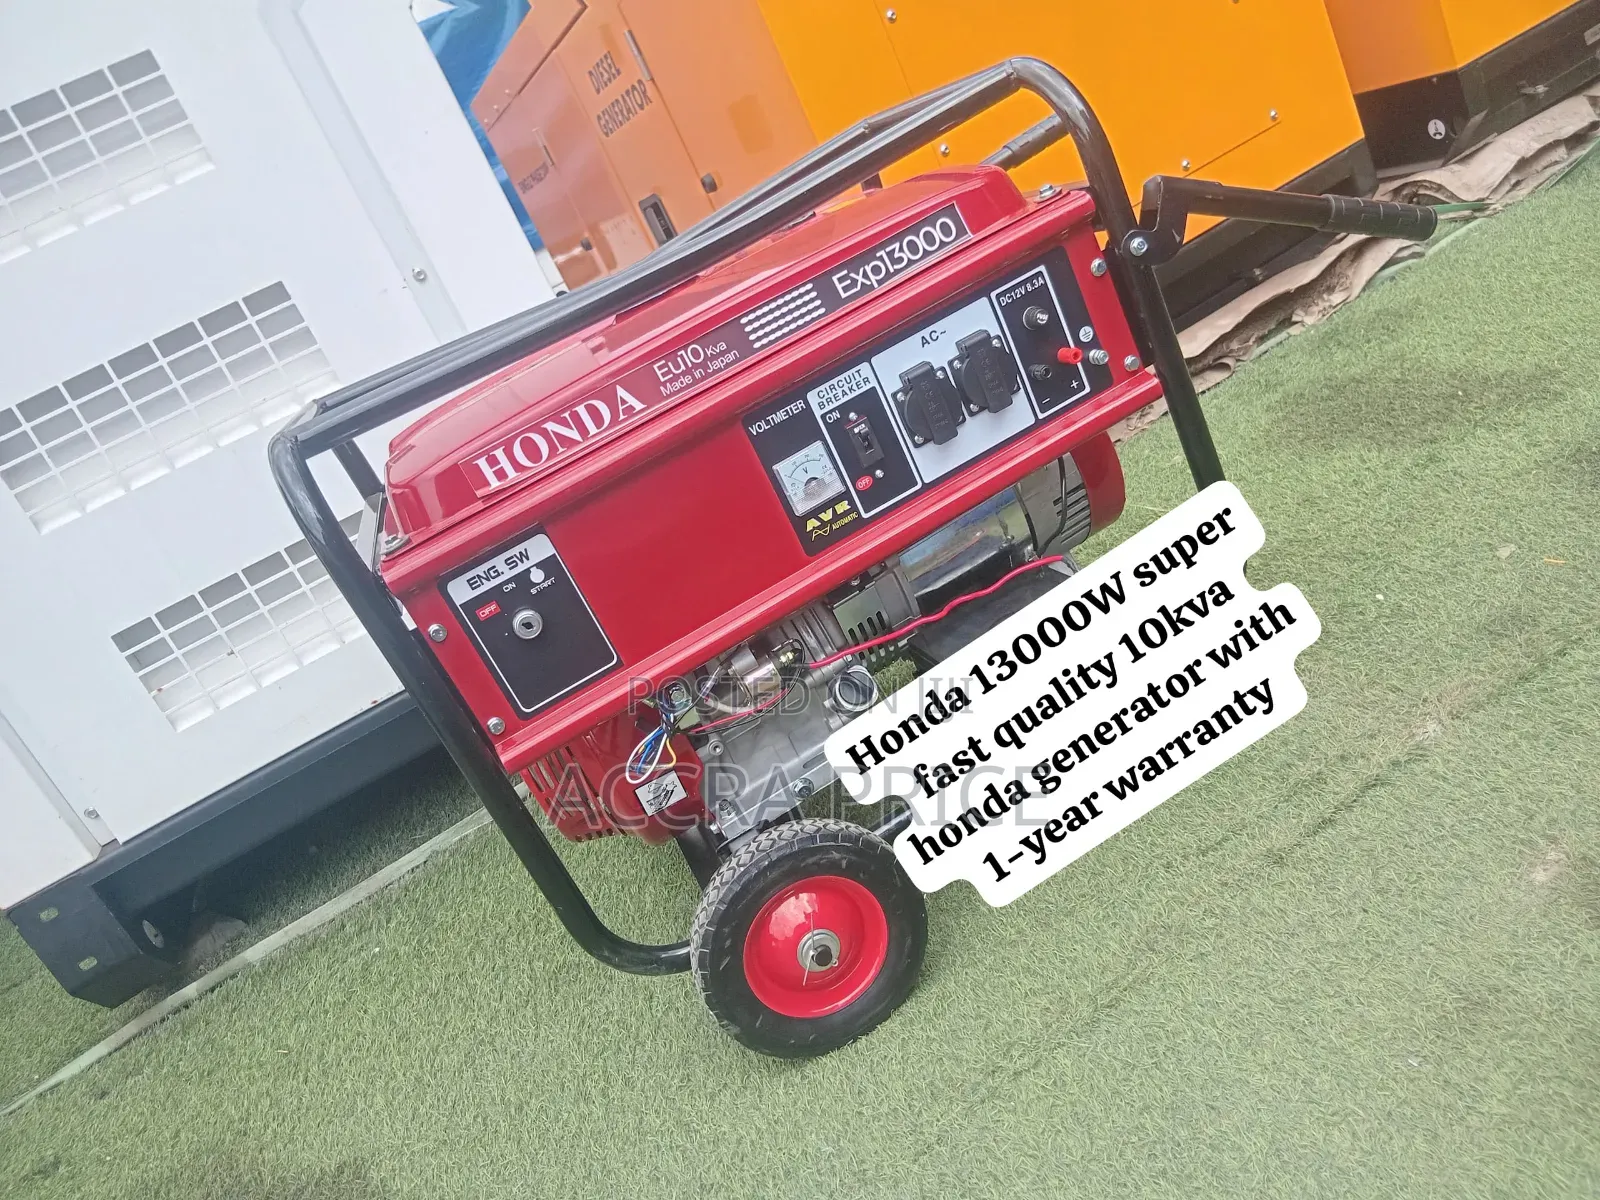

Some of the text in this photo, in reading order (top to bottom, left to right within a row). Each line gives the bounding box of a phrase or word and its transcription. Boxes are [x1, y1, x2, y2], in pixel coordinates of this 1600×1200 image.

[587, 51, 622, 95] DIESEL
[596, 78, 652, 138] GENERATOR
[833, 217, 957, 299] Exp13000
[1000, 276, 1045, 307] DC12V 8.3A
[653, 341, 727, 382] Eu10 Kva
[660, 350, 739, 396] Made in Japan
[816, 368, 864, 400] CIRCUIT
[817, 376, 871, 411] BREAKER
[748, 400, 806, 437] VOLTMETER
[825, 409, 840, 423] ON
[473, 384, 647, 491] HONDA
[857, 477, 870, 489] OFF
[806, 500, 851, 532] AVR
[832, 511, 859, 531] AUTOMATIC
[467, 548, 530, 592] ENG. SW
[530, 576, 556, 595] START
[503, 581, 516, 593] ON
[479, 603, 497, 618] OFF
